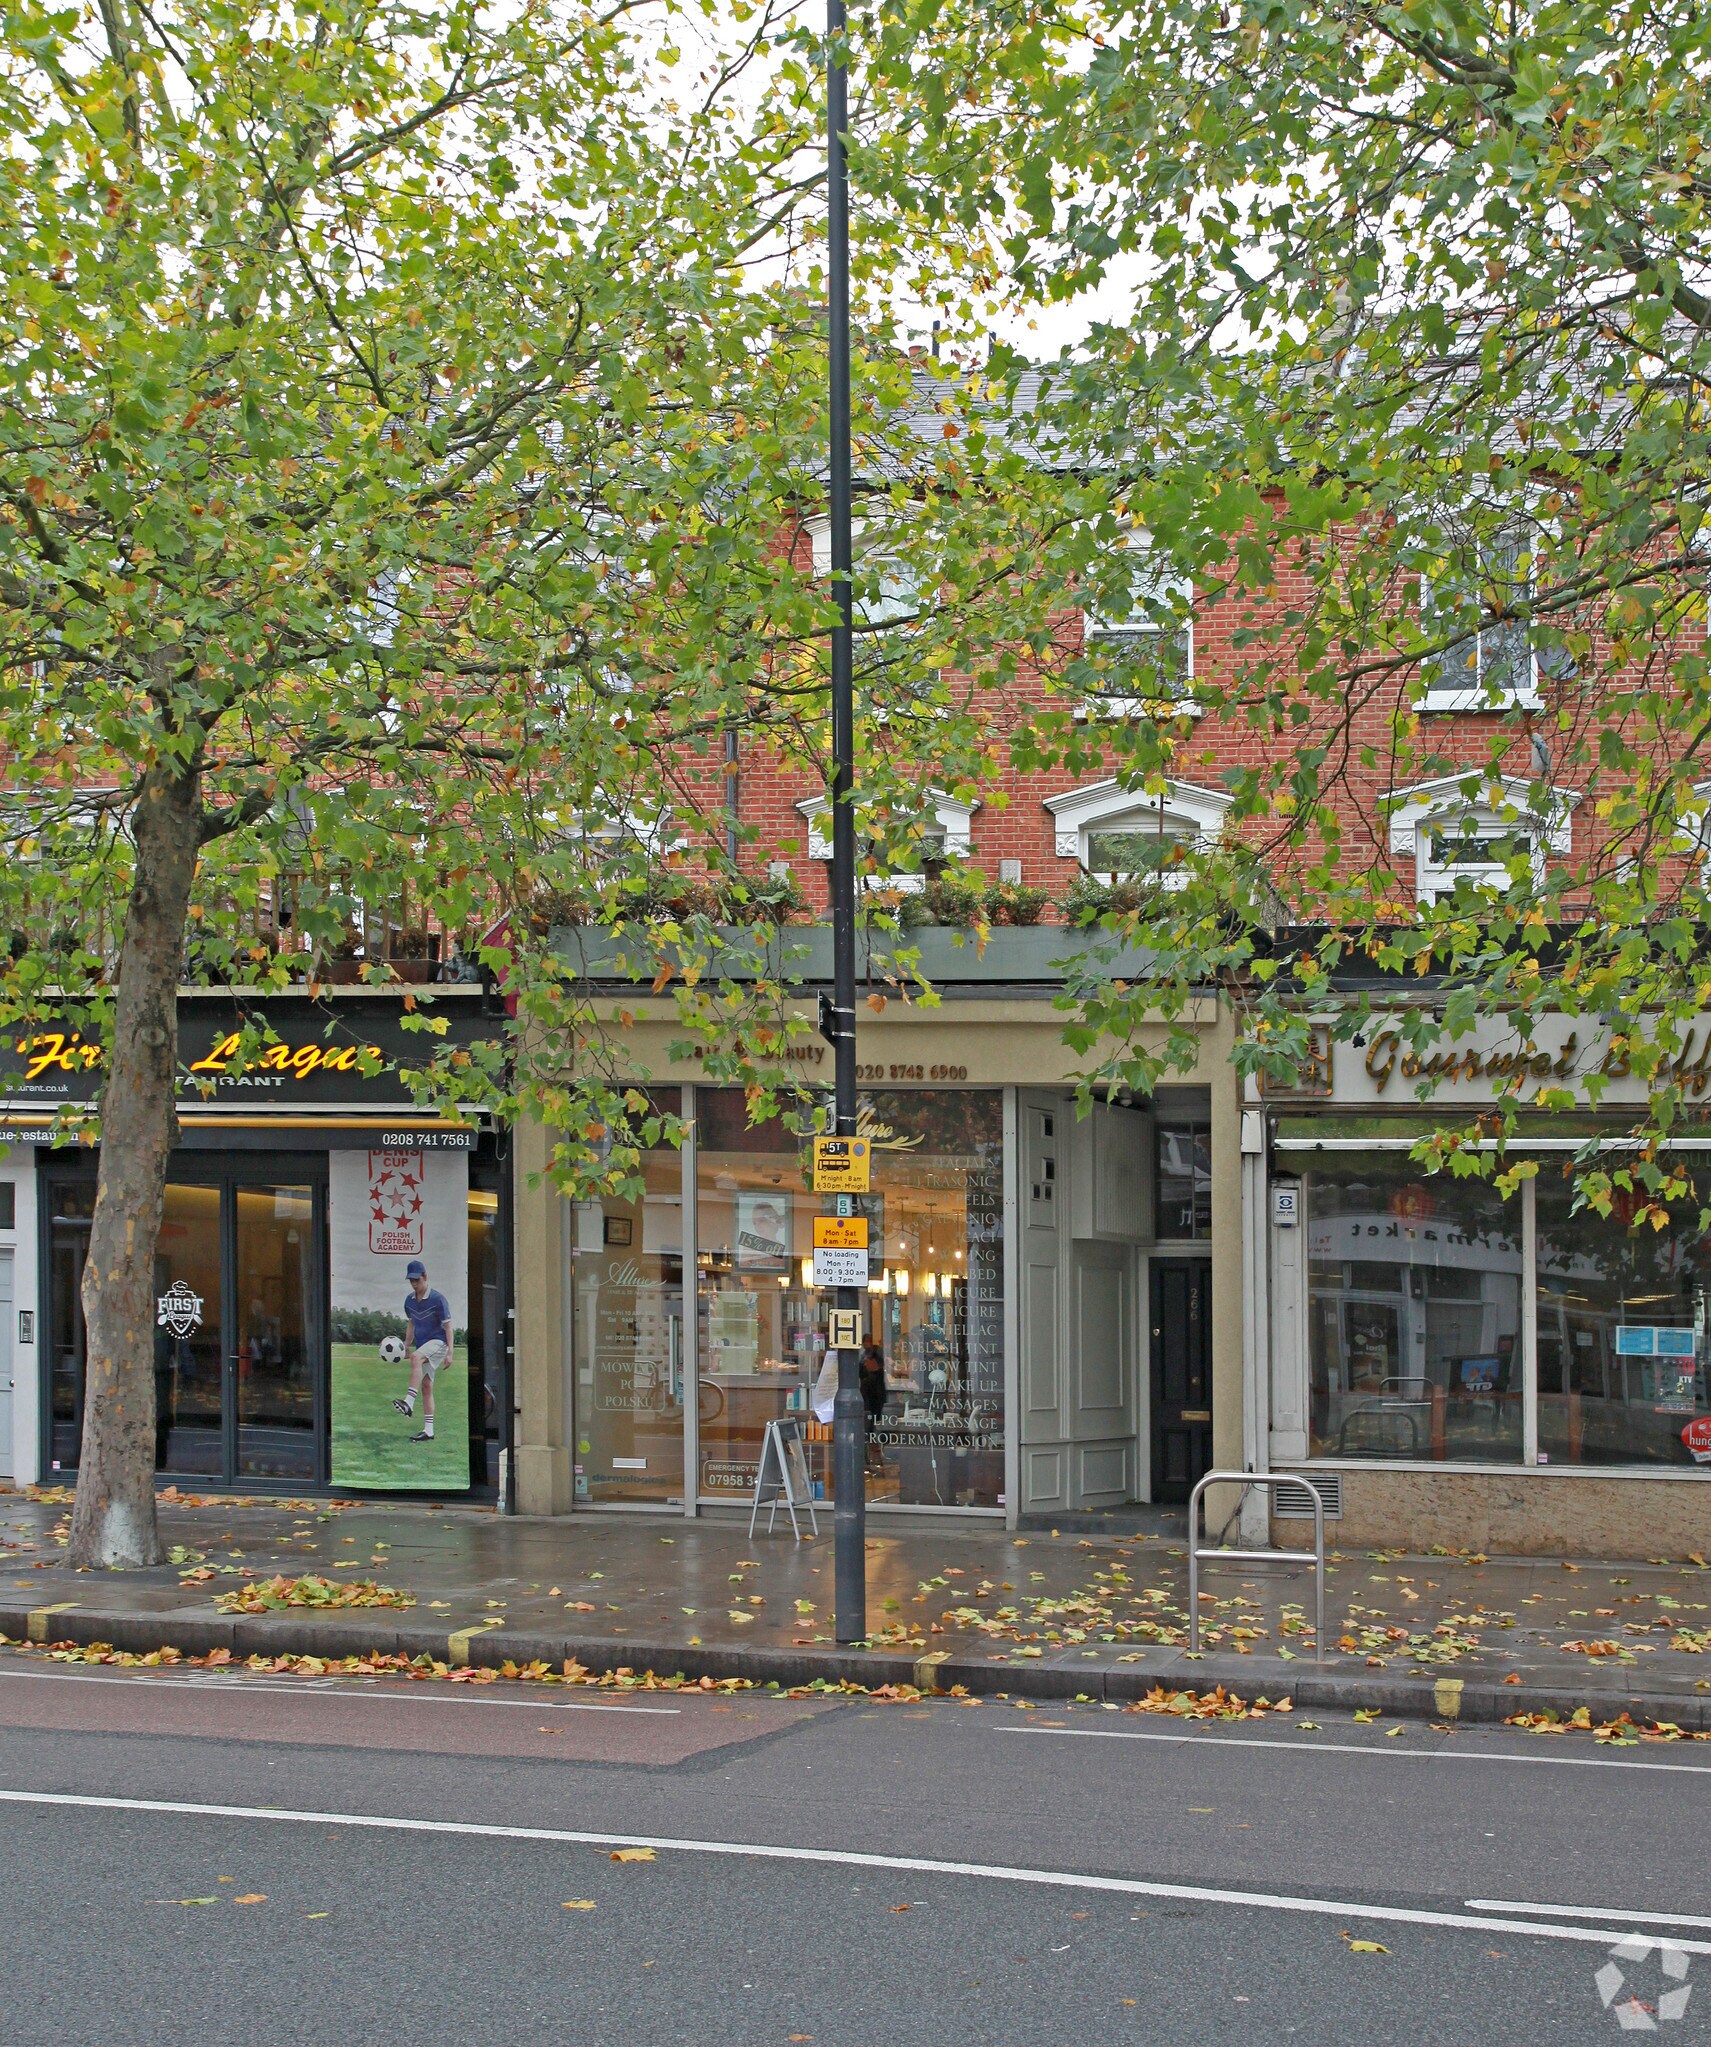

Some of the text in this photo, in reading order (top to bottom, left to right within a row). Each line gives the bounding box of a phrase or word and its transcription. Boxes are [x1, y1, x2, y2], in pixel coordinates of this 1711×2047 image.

[190, 1032, 384, 1078] Lague
[680, 1044, 721, 1060] air
[1365, 1030, 1576, 1094] Gourmet
[856, 1064, 968, 1080] 020 8748 6900
[382, 1133, 471, 1147] 0208 741 7561
[829, 1142, 841, 1152] 5T
[383, 1157, 409, 1167] CUP
[382, 1231, 410, 1239] POLISH
[845, 1229, 857, 1237] Sat
[376, 1237, 416, 1245] FOOTBALL
[741, 1233, 783, 1256] 15% off
[834, 1251, 859, 1259] loading
[157, 1297, 204, 1314] FIRST
[1190, 1288, 1198, 1321] 266
[965, 1342, 998, 1354] TINT
[965, 1361, 998, 1373] TINT
[980, 1380, 998, 1392] UP
[605, 1395, 654, 1407] POLSKU
[708, 1464, 750, 1472] EMERGENCY
[709, 1474, 744, 1487] 07958
